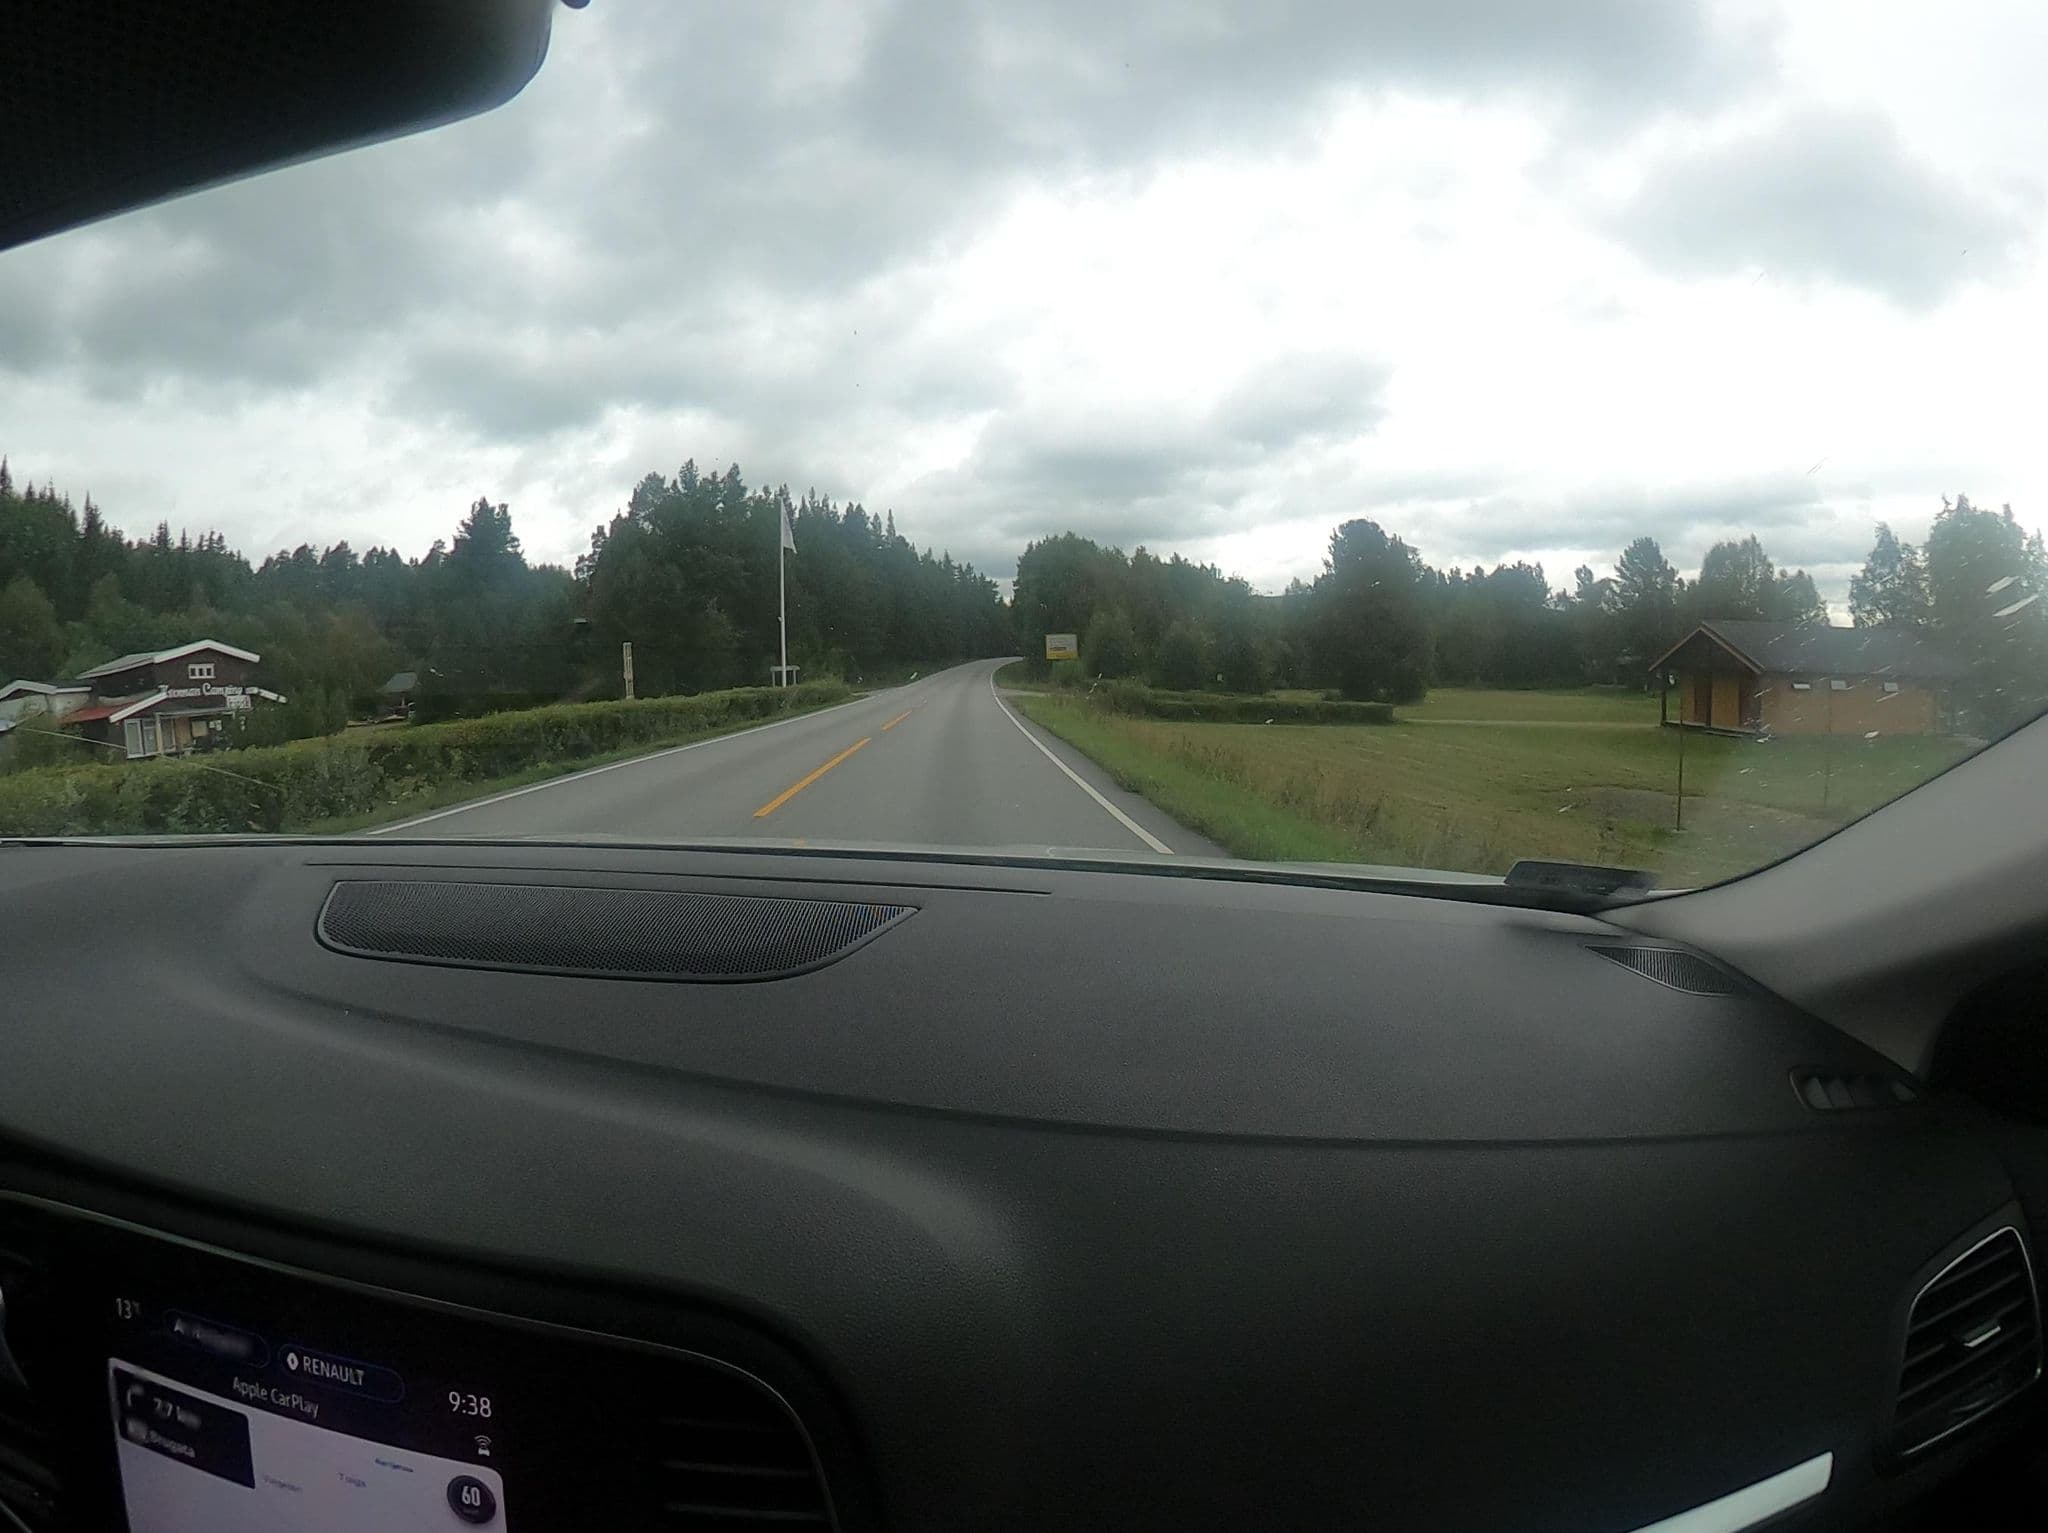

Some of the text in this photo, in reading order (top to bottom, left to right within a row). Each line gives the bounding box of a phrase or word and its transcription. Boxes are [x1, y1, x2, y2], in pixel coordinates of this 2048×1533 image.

[303, 1355, 365, 1386] RENAULT
[232, 1375, 320, 1419] Apple CarPlay
[448, 1391, 493, 1418] 9:38
[460, 1485, 482, 1508] 60
